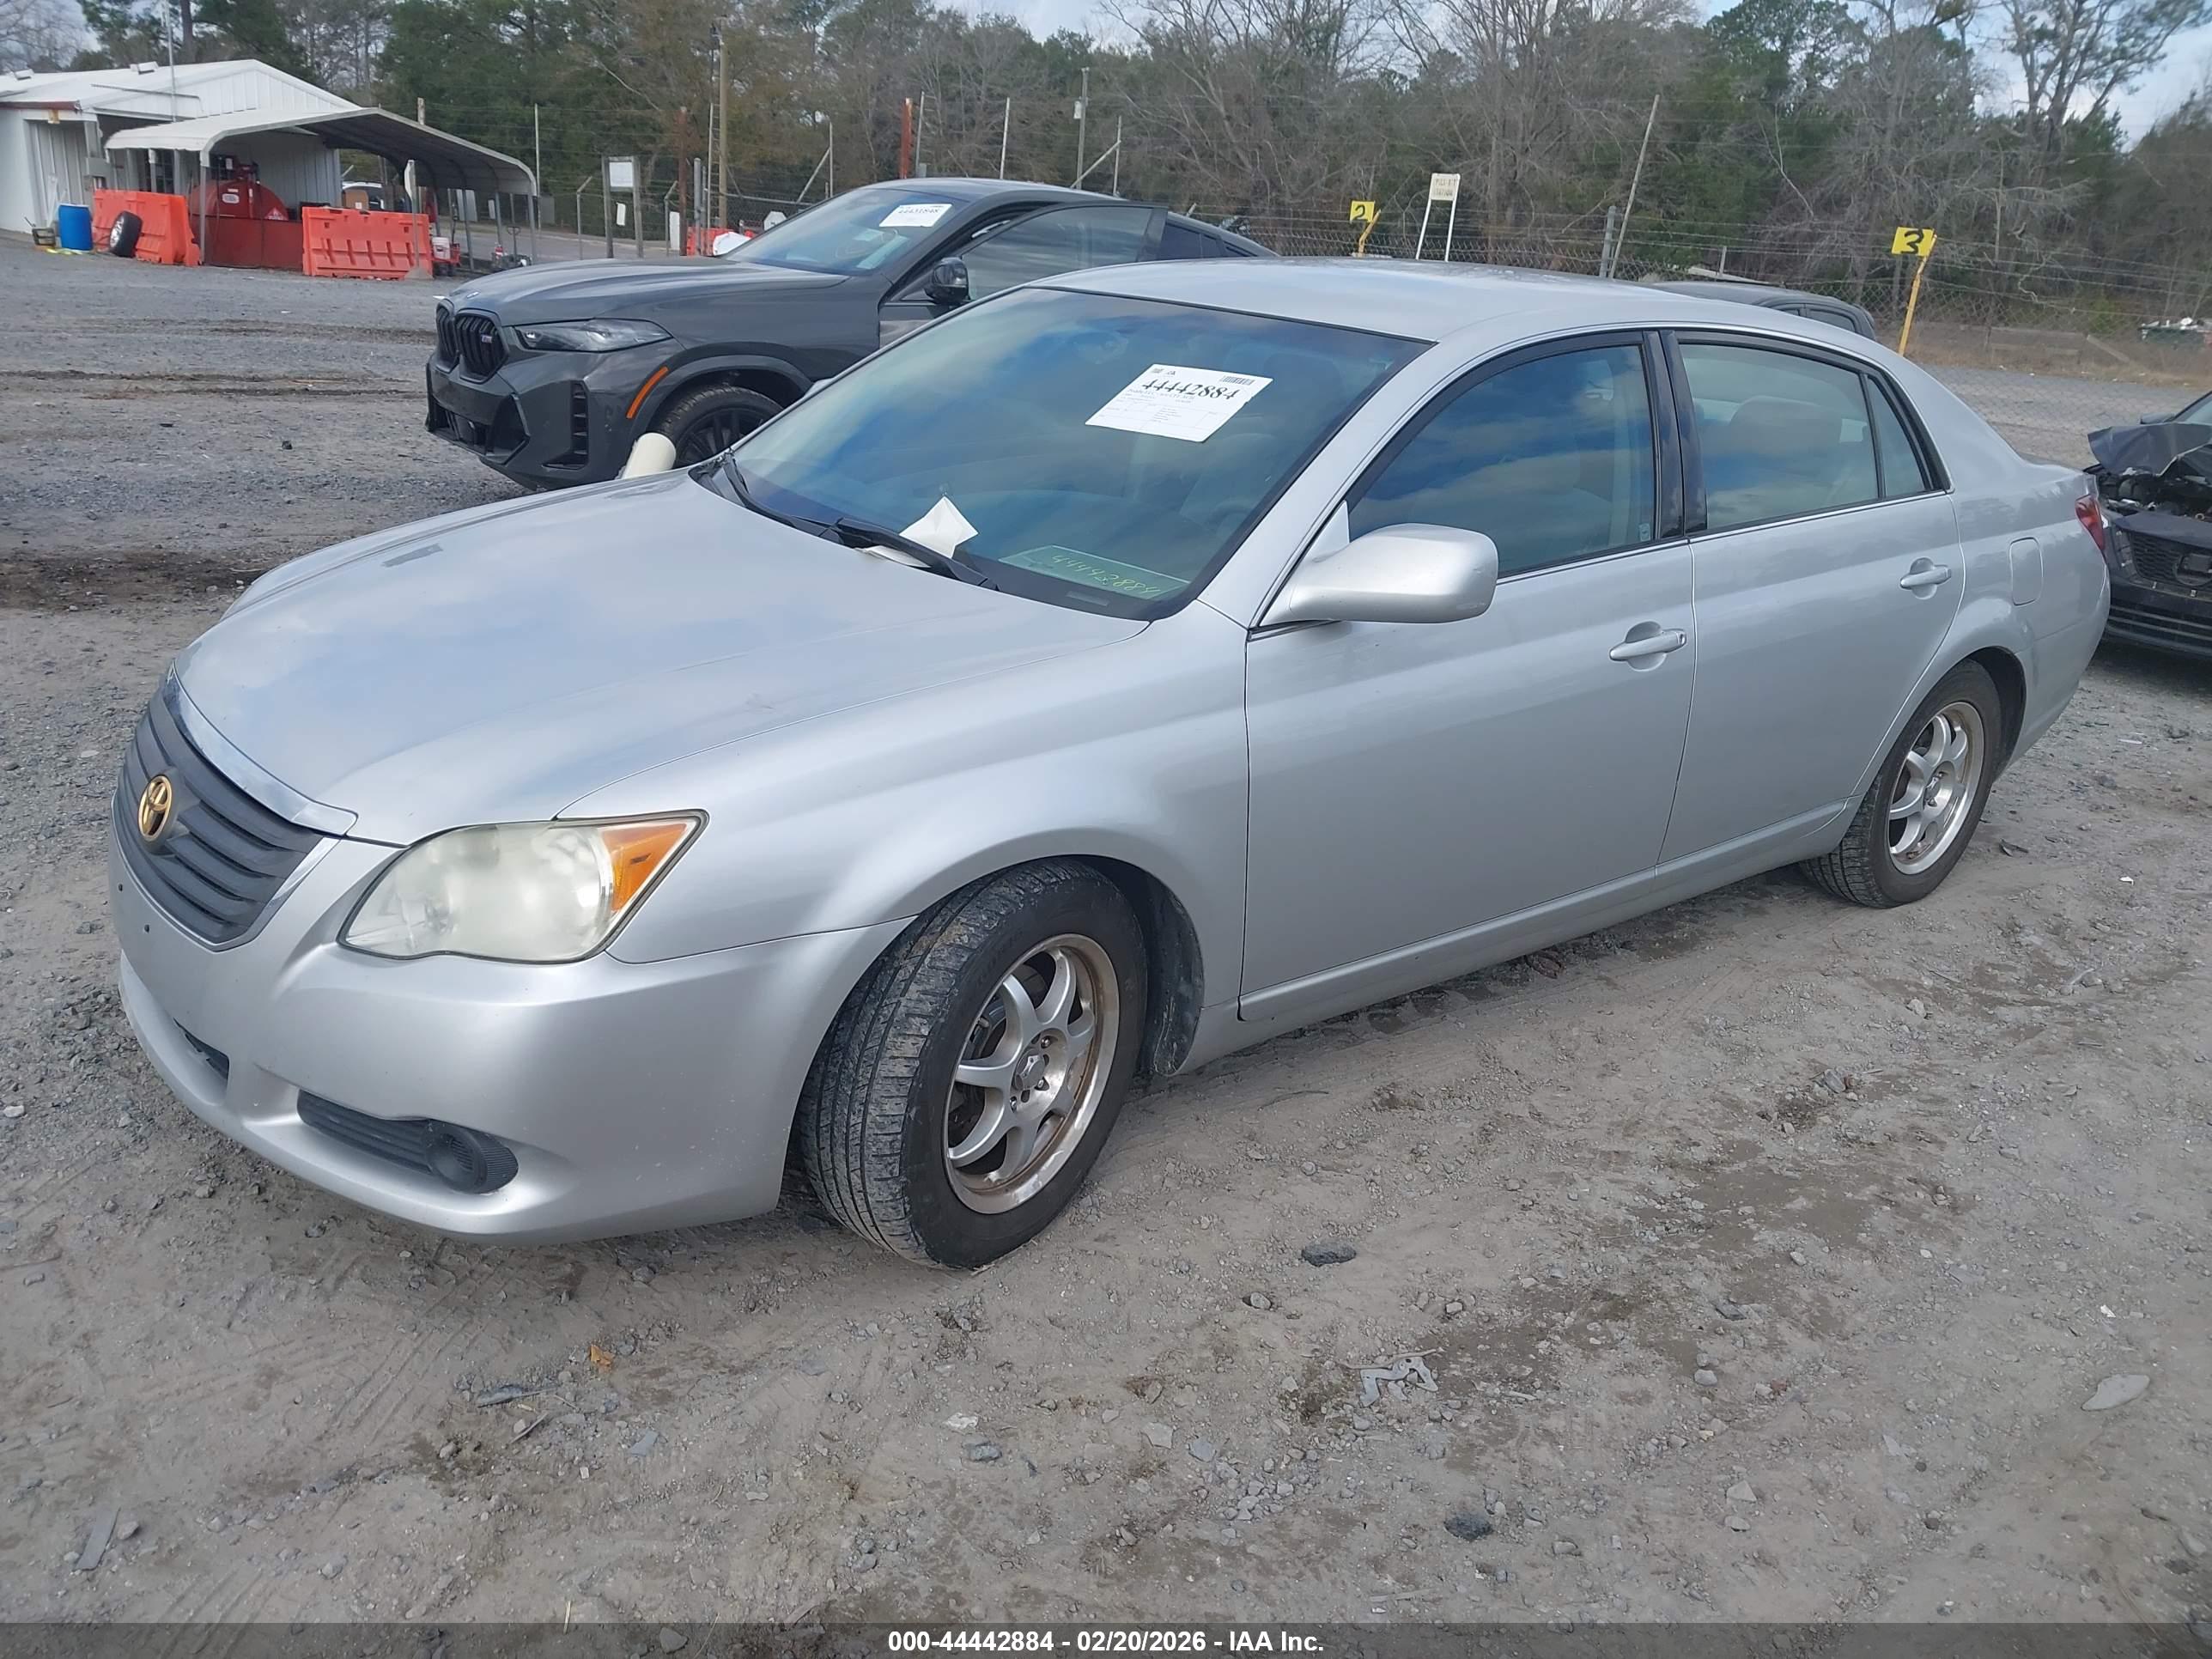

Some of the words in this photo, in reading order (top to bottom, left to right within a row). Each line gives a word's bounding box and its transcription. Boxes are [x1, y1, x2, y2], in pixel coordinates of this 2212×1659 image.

[1352, 204, 1367, 220] 2
[1901, 228, 1924, 254] 3
[1142, 379, 1241, 400] 44442884
